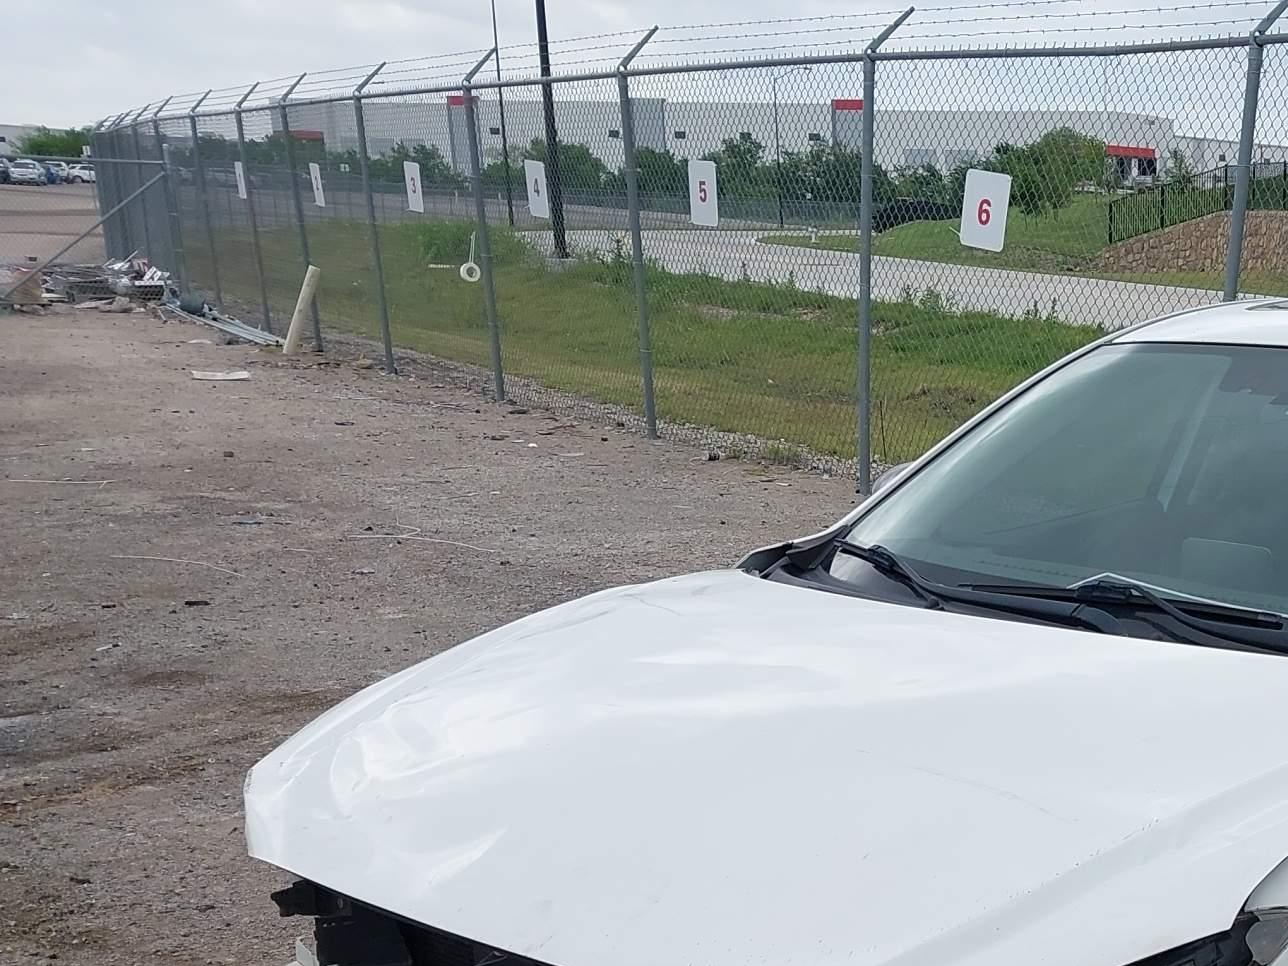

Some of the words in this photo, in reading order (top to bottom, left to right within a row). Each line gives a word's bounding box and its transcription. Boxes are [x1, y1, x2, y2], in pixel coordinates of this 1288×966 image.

[410, 176, 417, 194] 3
[533, 177, 540, 197] 4
[699, 181, 707, 203] 5
[977, 198, 992, 226] 6
